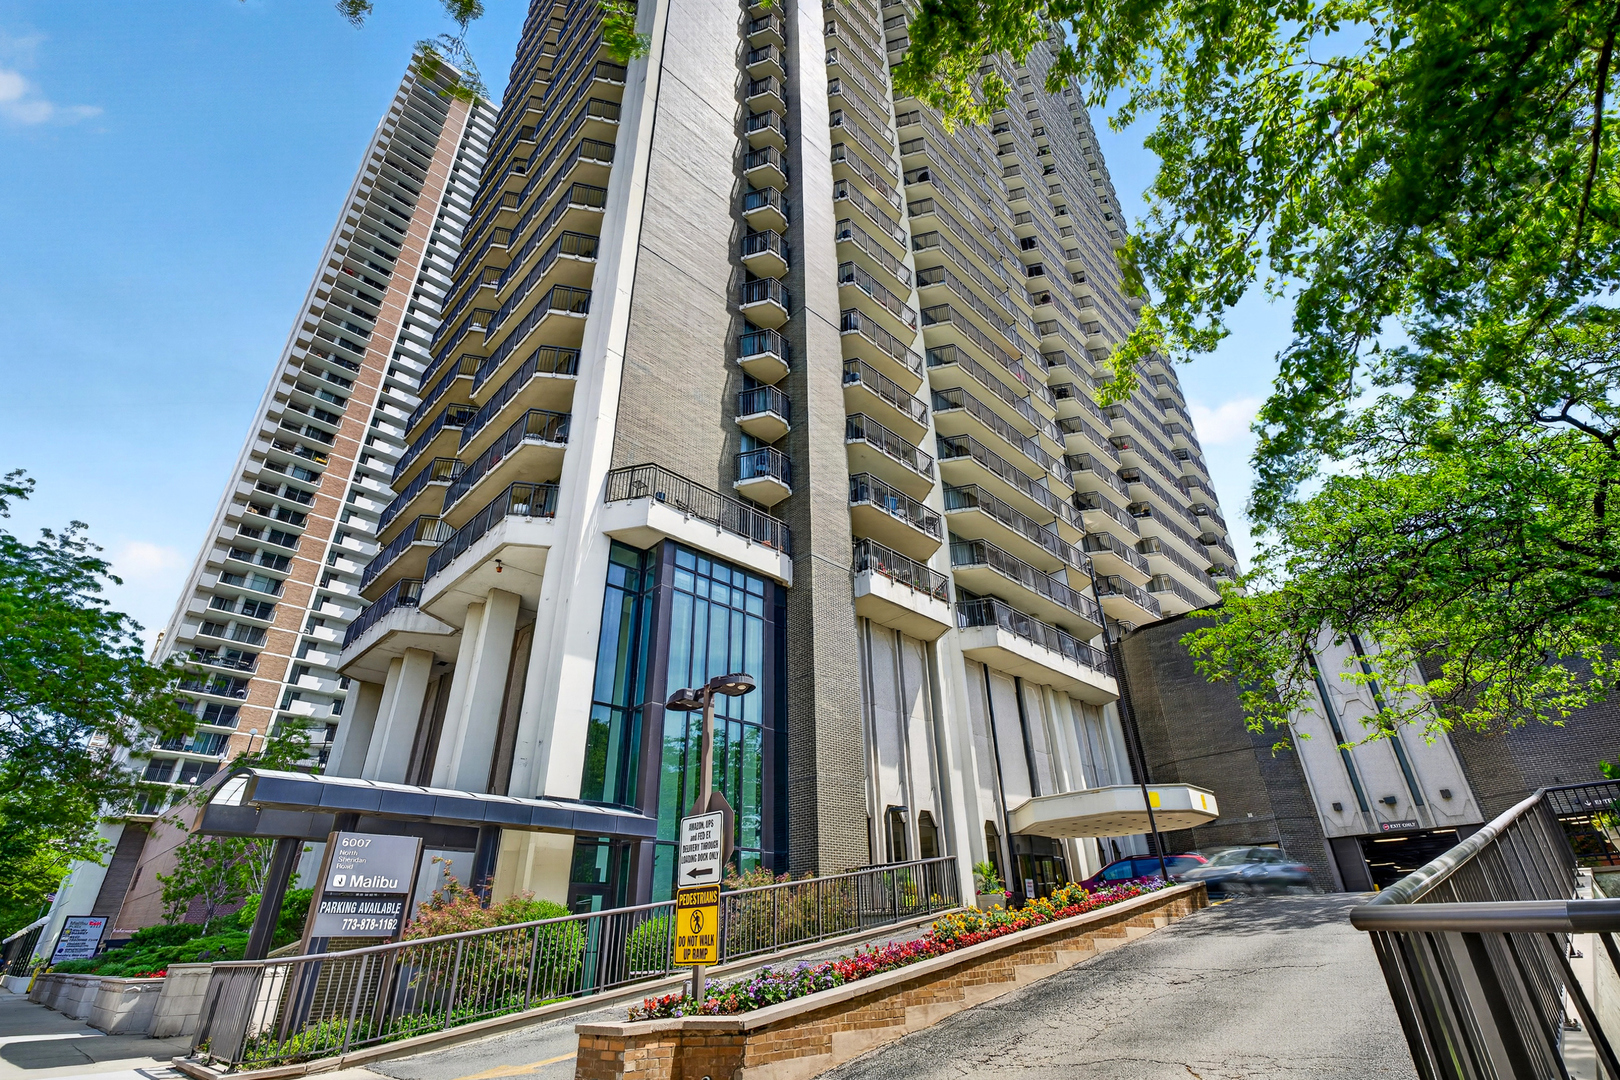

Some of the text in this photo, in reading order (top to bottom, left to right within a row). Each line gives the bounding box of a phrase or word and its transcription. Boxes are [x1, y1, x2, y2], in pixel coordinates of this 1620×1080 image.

[688, 819, 714, 831] AMAZON, UPS
[690, 831, 712, 841] and FED EX
[342, 838, 371, 848] 6007
[683, 840, 719, 853] DELIVERY THROUGH
[338, 856, 367, 864] Sheridan
[681, 851, 719, 864] LOADING DOCK ONLY
[349, 875, 398, 889] Malibu
[679, 891, 718, 907] PEDESTRIANS
[320, 901, 402, 914] PARKING AVAILABLE
[341, 918, 398, 930] 773-878-1162
[678, 934, 715, 947] DO NOT WALK
[683, 948, 709, 960] UP RAMP
